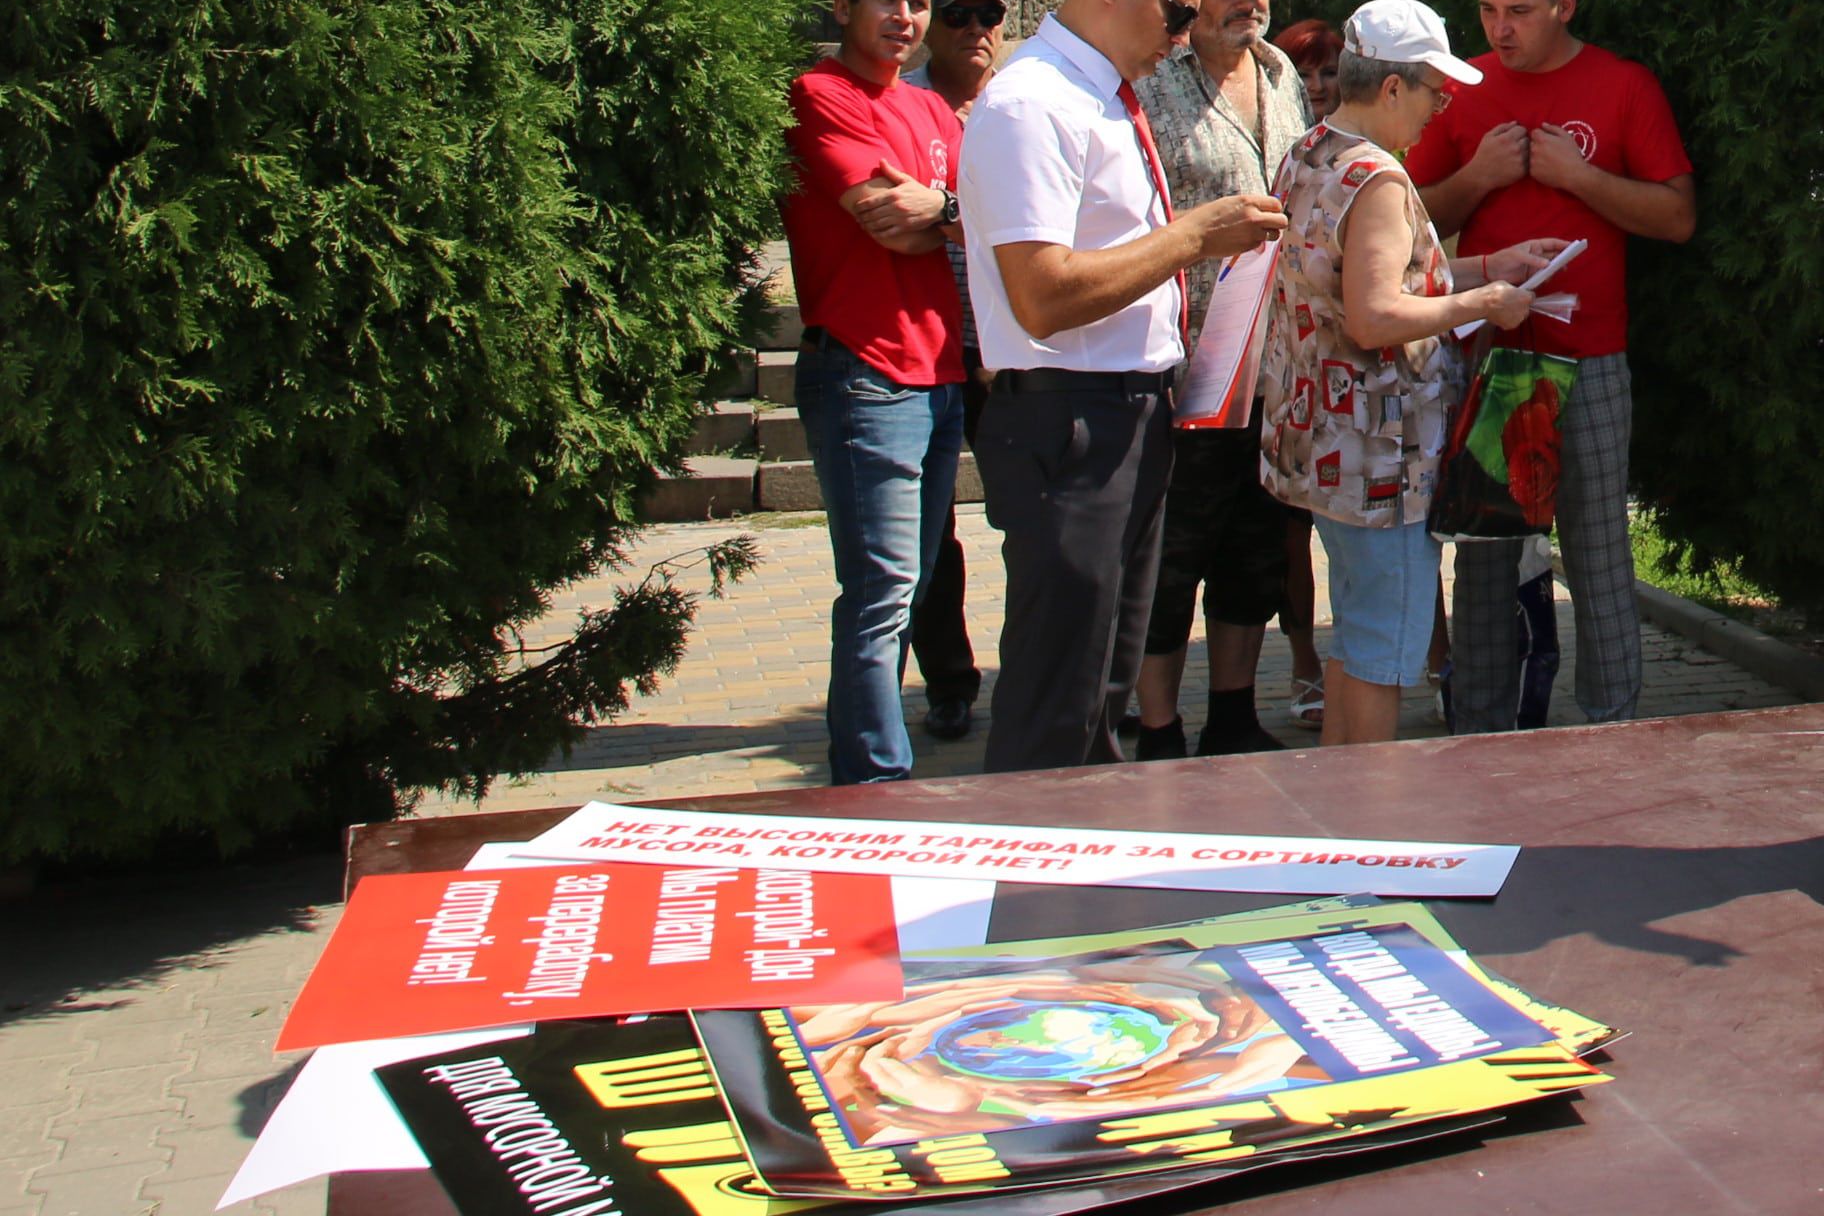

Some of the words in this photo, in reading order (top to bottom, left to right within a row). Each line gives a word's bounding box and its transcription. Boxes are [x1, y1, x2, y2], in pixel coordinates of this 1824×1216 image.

[578, 836, 752, 857] МУСОРА,
[767, 844, 968, 865] КОТОРОЙ
[975, 854, 1074, 871] НЕТ!
[603, 821, 690, 835] НЕТ
[695, 826, 906, 846] ВЫСОКИМ
[918, 835, 1116, 855] ТАРИФАМ
[1126, 845, 1176, 858] ЗА
[1191, 848, 1467, 870] СОРТИРОВКУ
[553, 873, 611, 895] за
[659, 867, 740, 899] Мы
[415, 880, 502, 949] которой
[647, 899, 717, 966] платим
[735, 868, 836, 981] кострой-Дон
[406, 951, 488, 985] нет!
[502, 894, 614, 1006] переработку,
[1236, 941, 1314, 976] МЫ
[1312, 931, 1408, 983] КОГДА
[1357, 974, 1441, 1009] МЫ
[1262, 969, 1421, 1073] НЕПОБЕДИМЫ
[1386, 1000, 1503, 1062] ЕДИНЫ,
[422, 1056, 521, 1101] ДЛЯ
[463, 1091, 614, 1213] МУСОРНОЙ
[911, 1132, 1012, 1183] ДОМ
